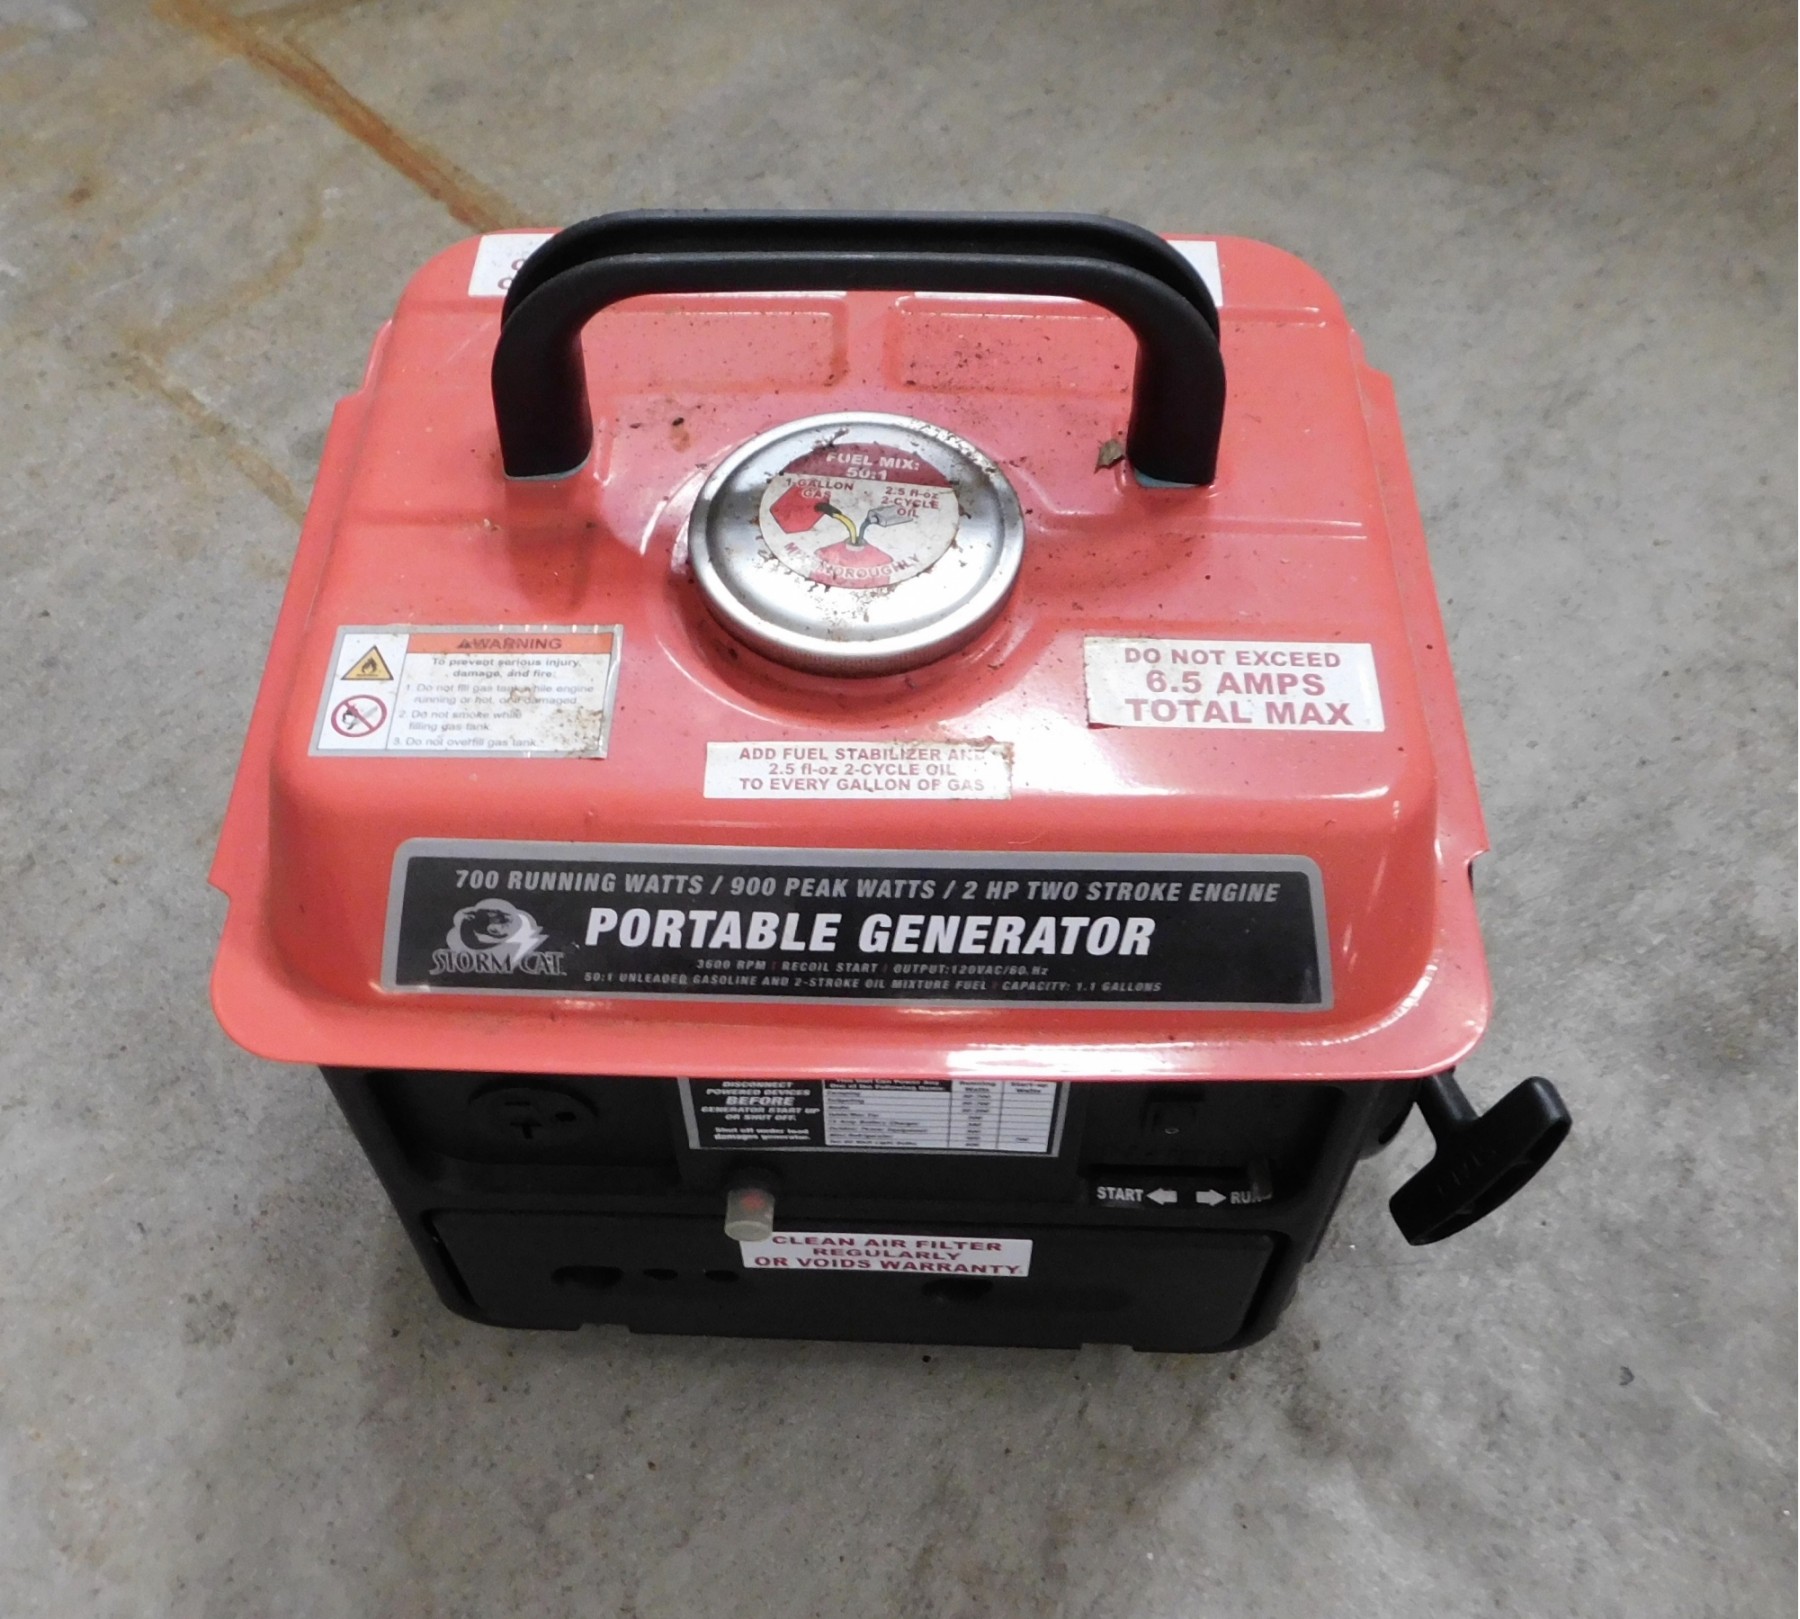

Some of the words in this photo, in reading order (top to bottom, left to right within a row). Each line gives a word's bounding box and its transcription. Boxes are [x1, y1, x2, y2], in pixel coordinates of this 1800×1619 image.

[826, 452, 873, 466] FUEL
[879, 456, 920, 470] MIX:
[846, 467, 888, 481] 50:1
[797, 479, 854, 491] GALLON
[885, 486, 906, 496] 2.5
[803, 489, 831, 499] GAS
[881, 496, 939, 510] 2-CYCLE
[897, 508, 919, 518] OIL
[472, 636, 562, 650] WARNING
[433, 657, 445, 666] To
[449, 658, 494, 667] prevent
[498, 658, 541, 667] serious
[1124, 647, 1161, 664] DO
[1171, 649, 1225, 665] NOT
[1236, 650, 1341, 668] EXCEED
[508, 669, 529, 678] and
[416, 683, 433, 692] Do
[436, 684, 454, 692] not
[473, 685, 493, 694] gas
[556, 686, 594, 696] engine
[1145, 670, 1201, 693] 6.5
[1216, 671, 1326, 696] AMPS
[414, 696, 457, 705] running
[460, 696, 470, 704] or
[411, 709, 427, 719] Do
[431, 709, 449, 719] not
[452, 710, 489, 719] smoke
[493, 711, 522, 719] while
[1124, 698, 1252, 724] TOTAL
[1265, 701, 1354, 726] MAX
[409, 721, 438, 732] filling
[441, 723, 462, 732] gas
[406, 736, 422, 746] Do
[426, 737, 443, 746] not
[447, 736, 484, 746] overfill
[487, 738, 508, 748] gas
[739, 747, 776, 760] ADD
[783, 748, 829, 761] FUEL
[834, 748, 941, 761] STABILIZER
[768, 763, 796, 775] 2.5
[801, 763, 838, 776] fl-oz
[844, 763, 920, 776] 2-CYCLE
[926, 764, 956, 776] OIL
[739, 777, 763, 790] TO
[770, 778, 829, 791] EVERY
[836, 778, 911, 792] GALLON
[917, 779, 941, 791] OF
[947, 778, 985, 791] GAS
[455, 870, 499, 890] 700
[507, 872, 616, 893] RUNNING
[624, 874, 704, 895] WATTS
[729, 876, 776, 897] 900
[785, 877, 848, 898] PEAK
[856, 878, 936, 901] WATTS
[962, 880, 977, 901] 2
[986, 881, 1017, 901] HP
[1027, 881, 1078, 901] TWO
[1086, 881, 1183, 902] STROKE
[1188, 883, 1282, 903] ENGINE
[584, 907, 842, 953] PORTABLE
[858, 913, 1156, 957] GENERATOR
[429, 948, 514, 975] STORM
[519, 950, 567, 976] CAT
[696, 959, 731, 970] 3600
[736, 960, 766, 971] RPM
[781, 961, 830, 972] RECOIL
[835, 962, 879, 973] START
[584, 971, 613, 982] 50:1
[618, 973, 688, 985] UNLEADED
[692, 974, 758, 986] GASOLINE
[761, 976, 790, 987] AND
[794, 976, 861, 988] 2-STROKE
[865, 979, 885, 989] OIL
[891, 979, 950, 990] MIXTURE
[955, 980, 987, 990] FUEL
[1001, 981, 1070, 992] CAPACITY:
[1076, 981, 1097, 992] 1.1
[1101, 981, 1163, 992] GALLONS
[725, 1095, 796, 1106] BEFORE
[768, 1106, 802, 1114] START
[1096, 1186, 1144, 1202] START
[771, 1234, 855, 1247] CLEAN
[863, 1236, 906, 1248] AIR
[915, 1239, 1003, 1251] FILTER
[812, 1247, 962, 1261] REGULARLY
[754, 1256, 788, 1267] OR
[796, 1257, 871, 1269] VOIDS
[880, 1260, 1021, 1275] WARRANTY
